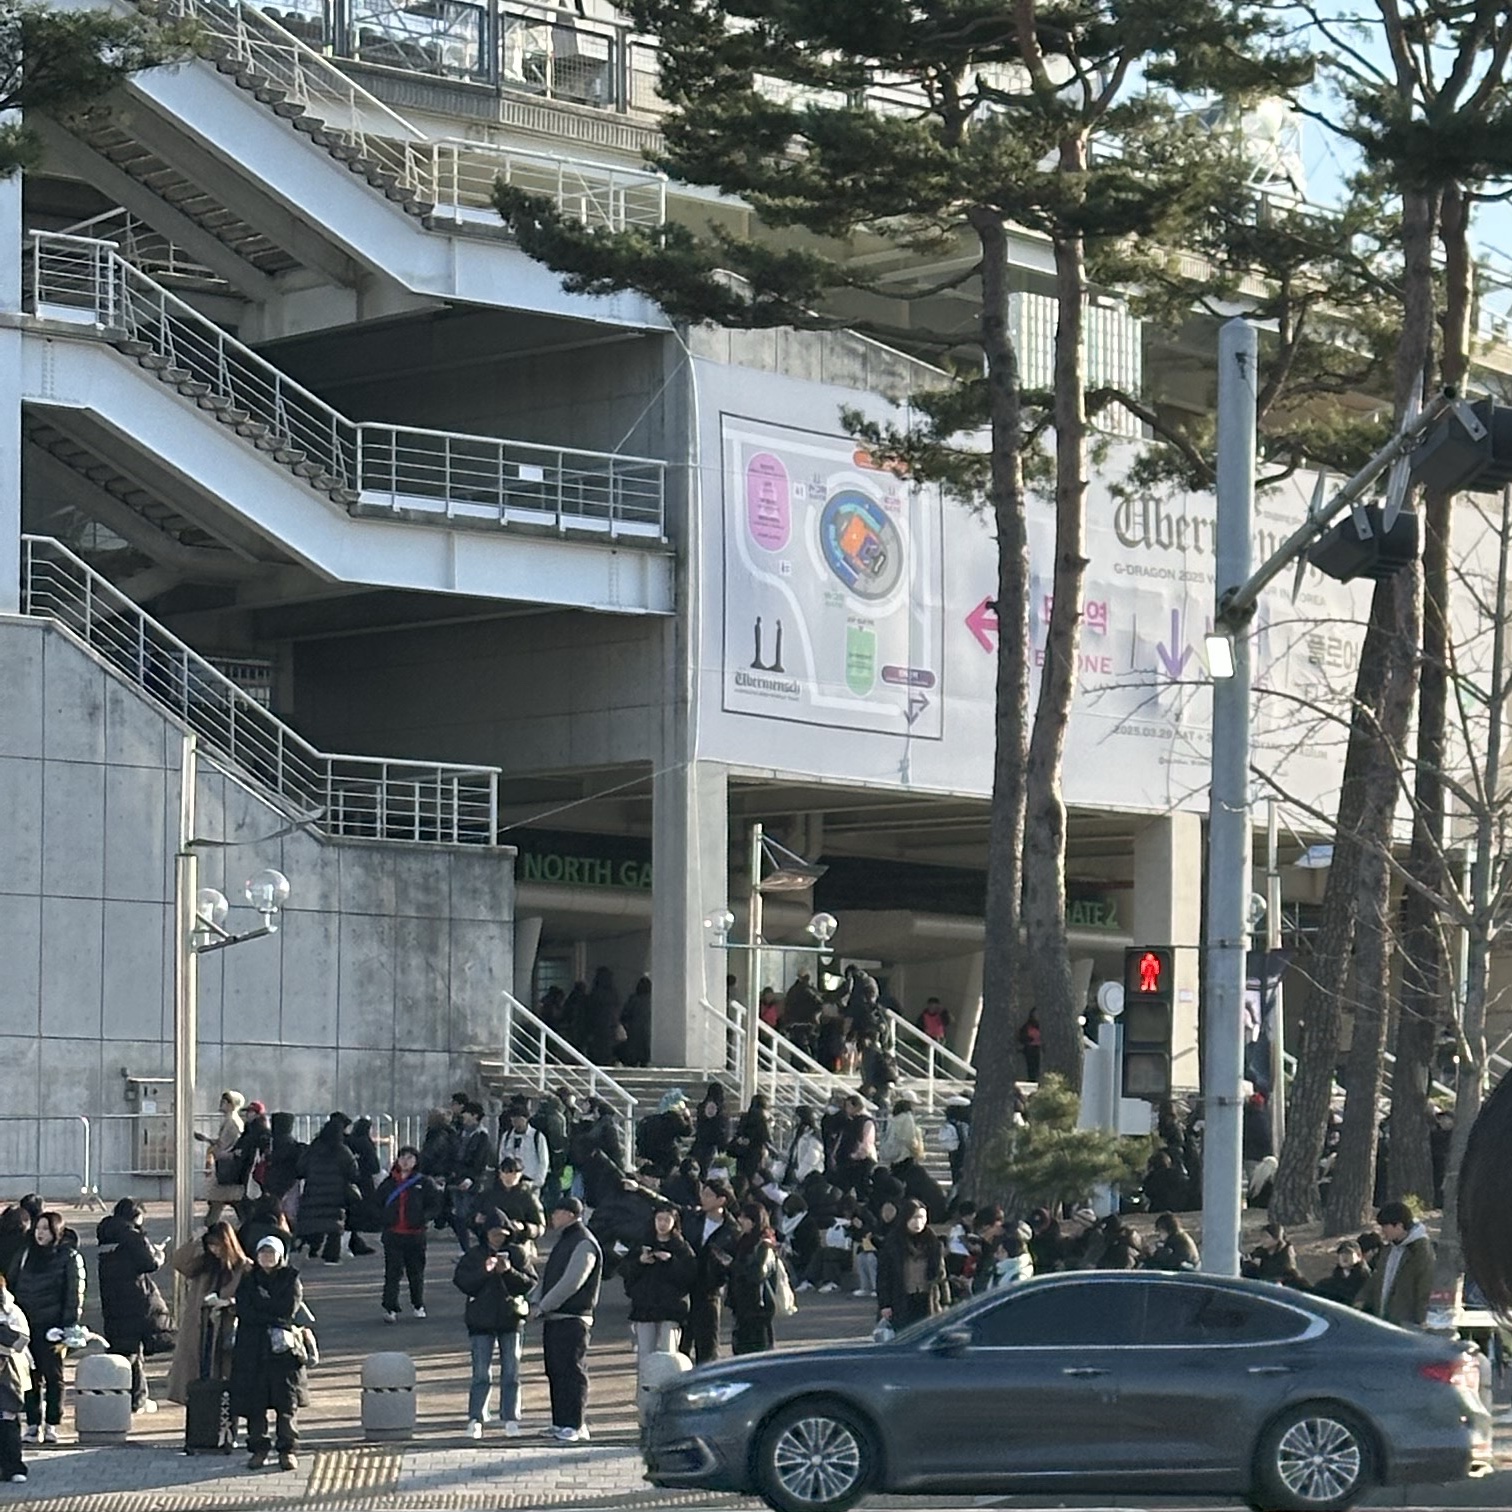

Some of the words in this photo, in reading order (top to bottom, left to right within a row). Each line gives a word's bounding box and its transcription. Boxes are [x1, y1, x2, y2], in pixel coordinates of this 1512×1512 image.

[1113, 563, 1176, 580] G-DRAGON
[1179, 570, 1205, 583] 2025
[525, 853, 611, 885] NORTH
[620, 860, 652, 889] GA
